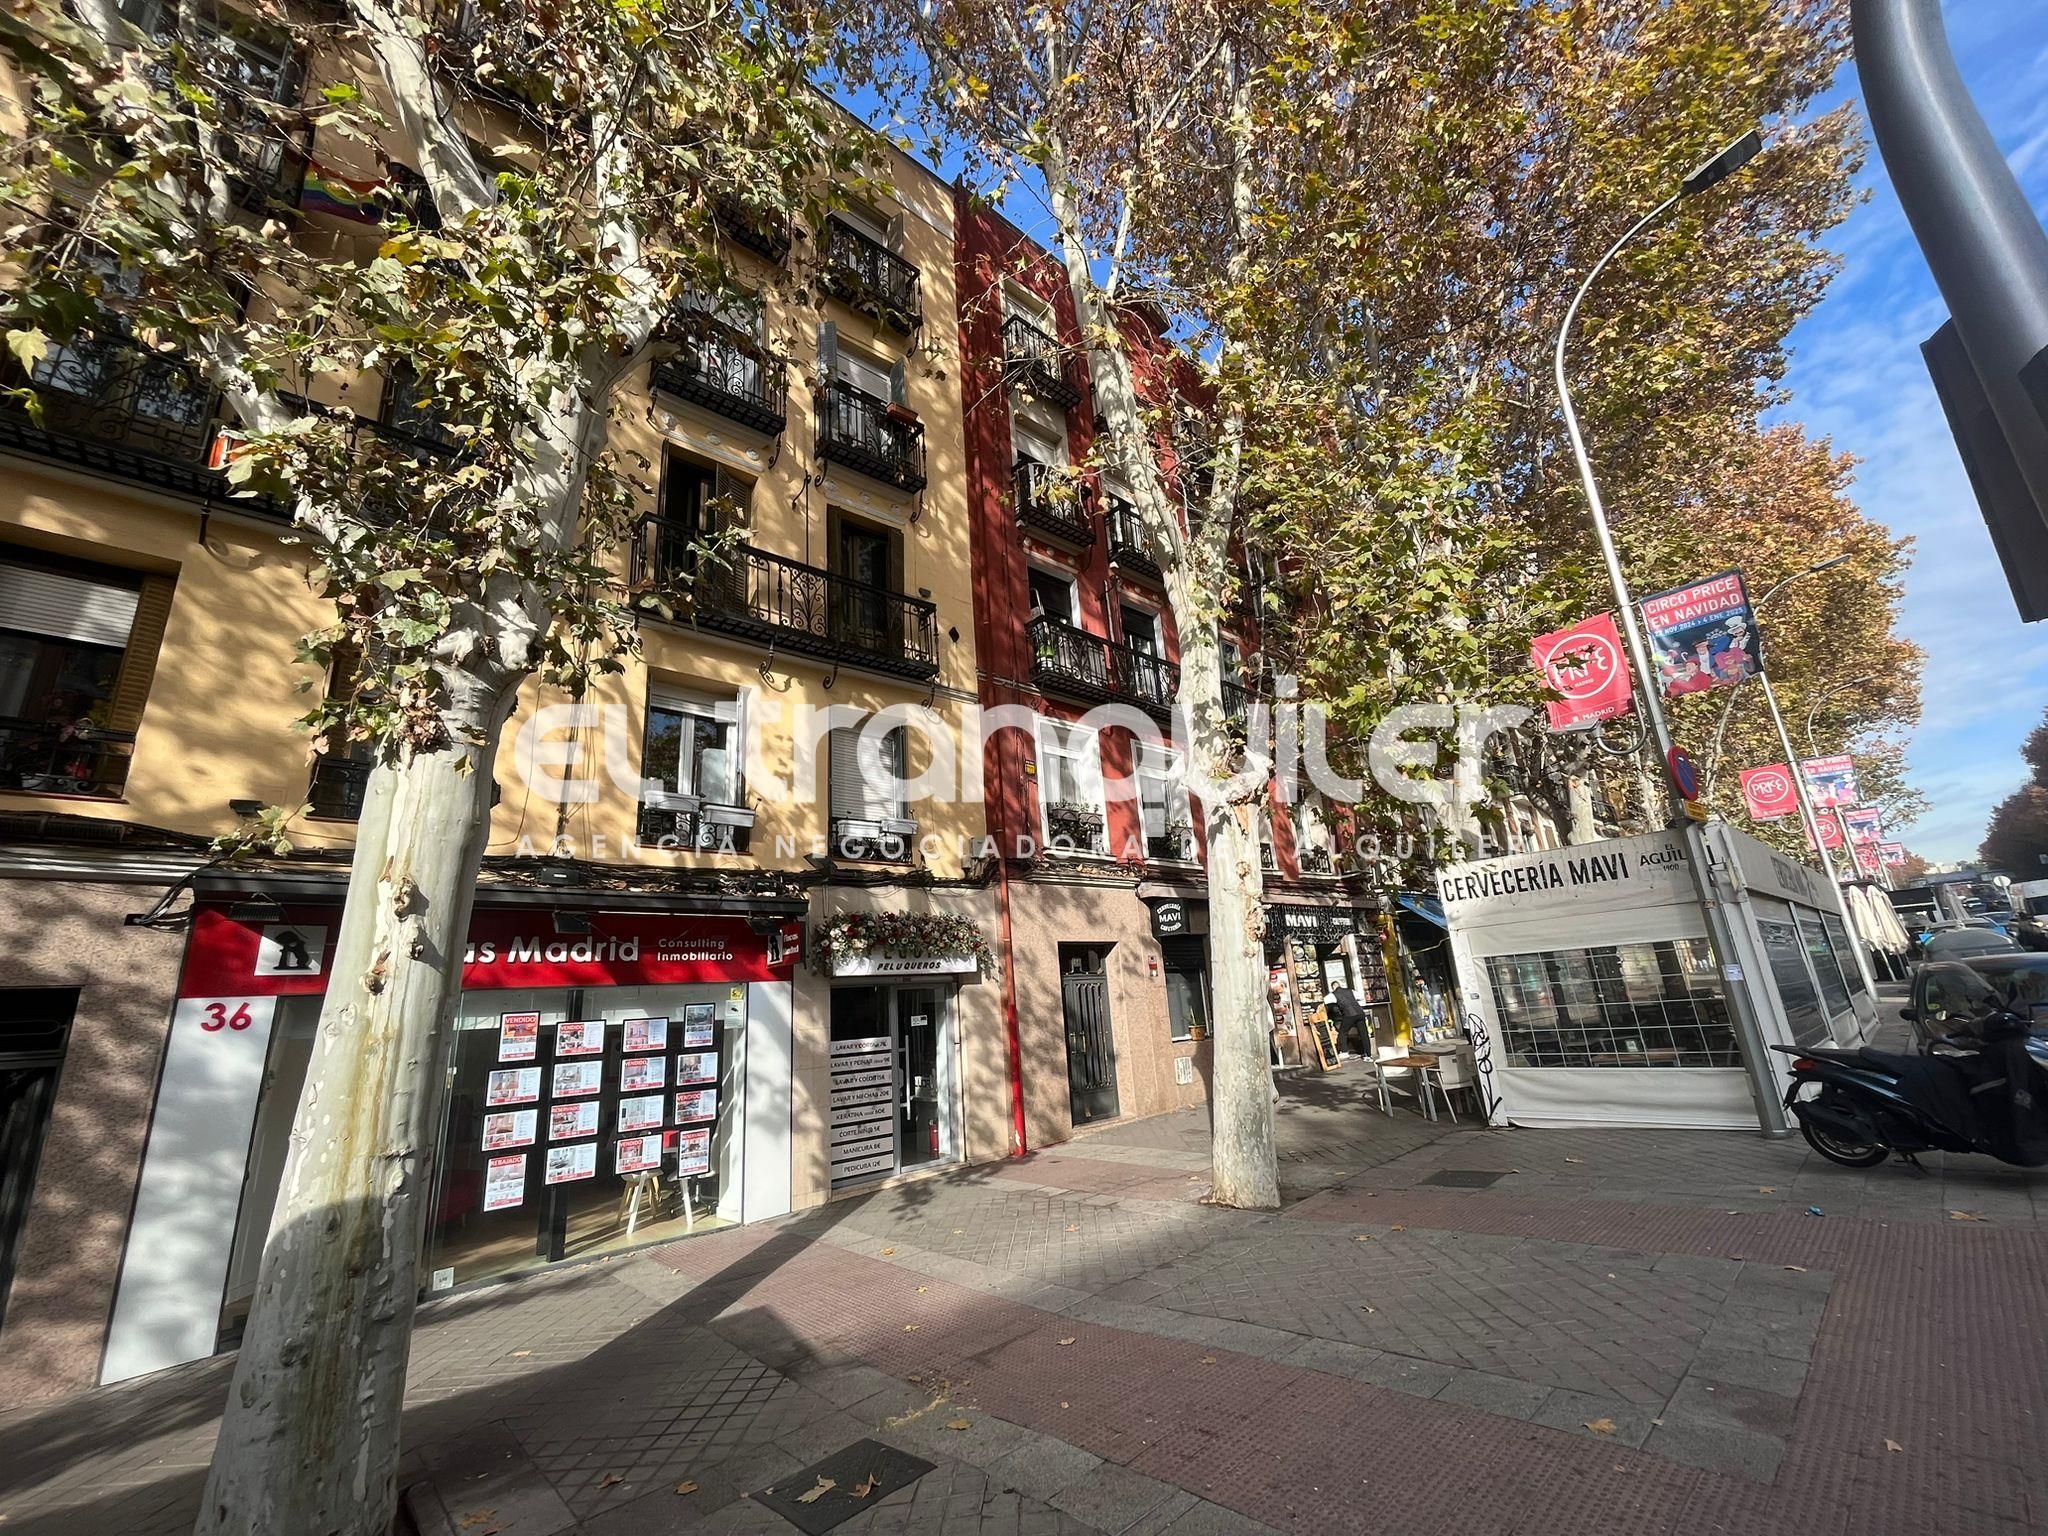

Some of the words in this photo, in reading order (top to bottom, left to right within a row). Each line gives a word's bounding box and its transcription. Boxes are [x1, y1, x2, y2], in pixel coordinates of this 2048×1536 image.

[1647, 593, 1687, 614] CIRCO
[1692, 577, 1736, 600] PRICE
[1651, 613, 1670, 629] EN
[1674, 593, 1741, 621] NAVIDAD
[1664, 624, 1678, 634] NOV
[1680, 621, 1696, 630] 2024
[1582, 706, 1615, 720] MADRID
[1664, 843, 1676, 851] EL
[1640, 850, 1688, 867] AGUIL
[1442, 860, 1565, 903] CERVECERÍA
[1568, 852, 1630, 886] MAVI
[1158, 912, 1182, 923] MAVI
[1284, 914, 1318, 928] MAVI
[464, 941, 496, 963] as
[507, 935, 639, 964] Madrid
[658, 938, 725, 950] Consulting
[657, 951, 733, 962] Inmobiliario
[876, 961, 942, 971] PELUQUEROS
[200, 1002, 252, 1032] 36
[505, 1016, 537, 1024] VENDIDO
[844, 1163, 872, 1173] PEDICURA
